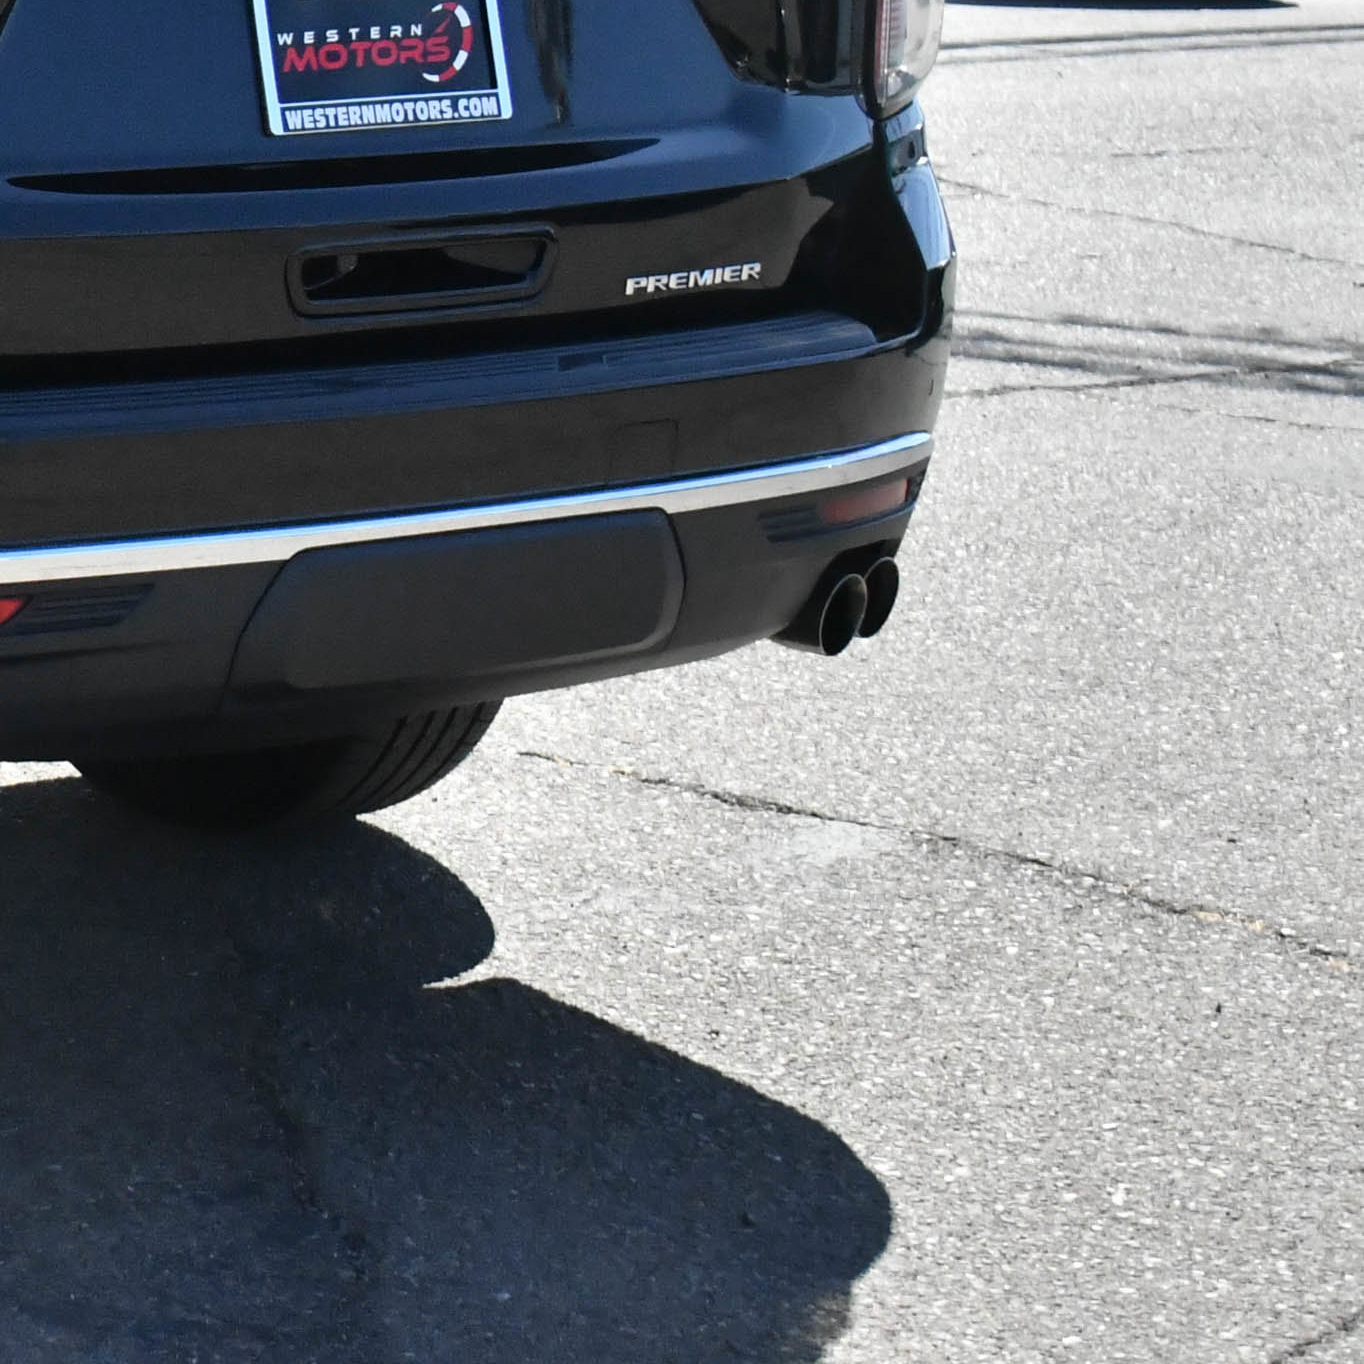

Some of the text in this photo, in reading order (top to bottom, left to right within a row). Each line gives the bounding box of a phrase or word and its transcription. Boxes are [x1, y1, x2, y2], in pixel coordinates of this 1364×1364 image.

[277, 24, 423, 46] WESTERN
[283, 35, 452, 73] MOTORS
[284, 96, 500, 131] WESTERNMOTORS.COM
[625, 262, 762, 296] PREMIER
